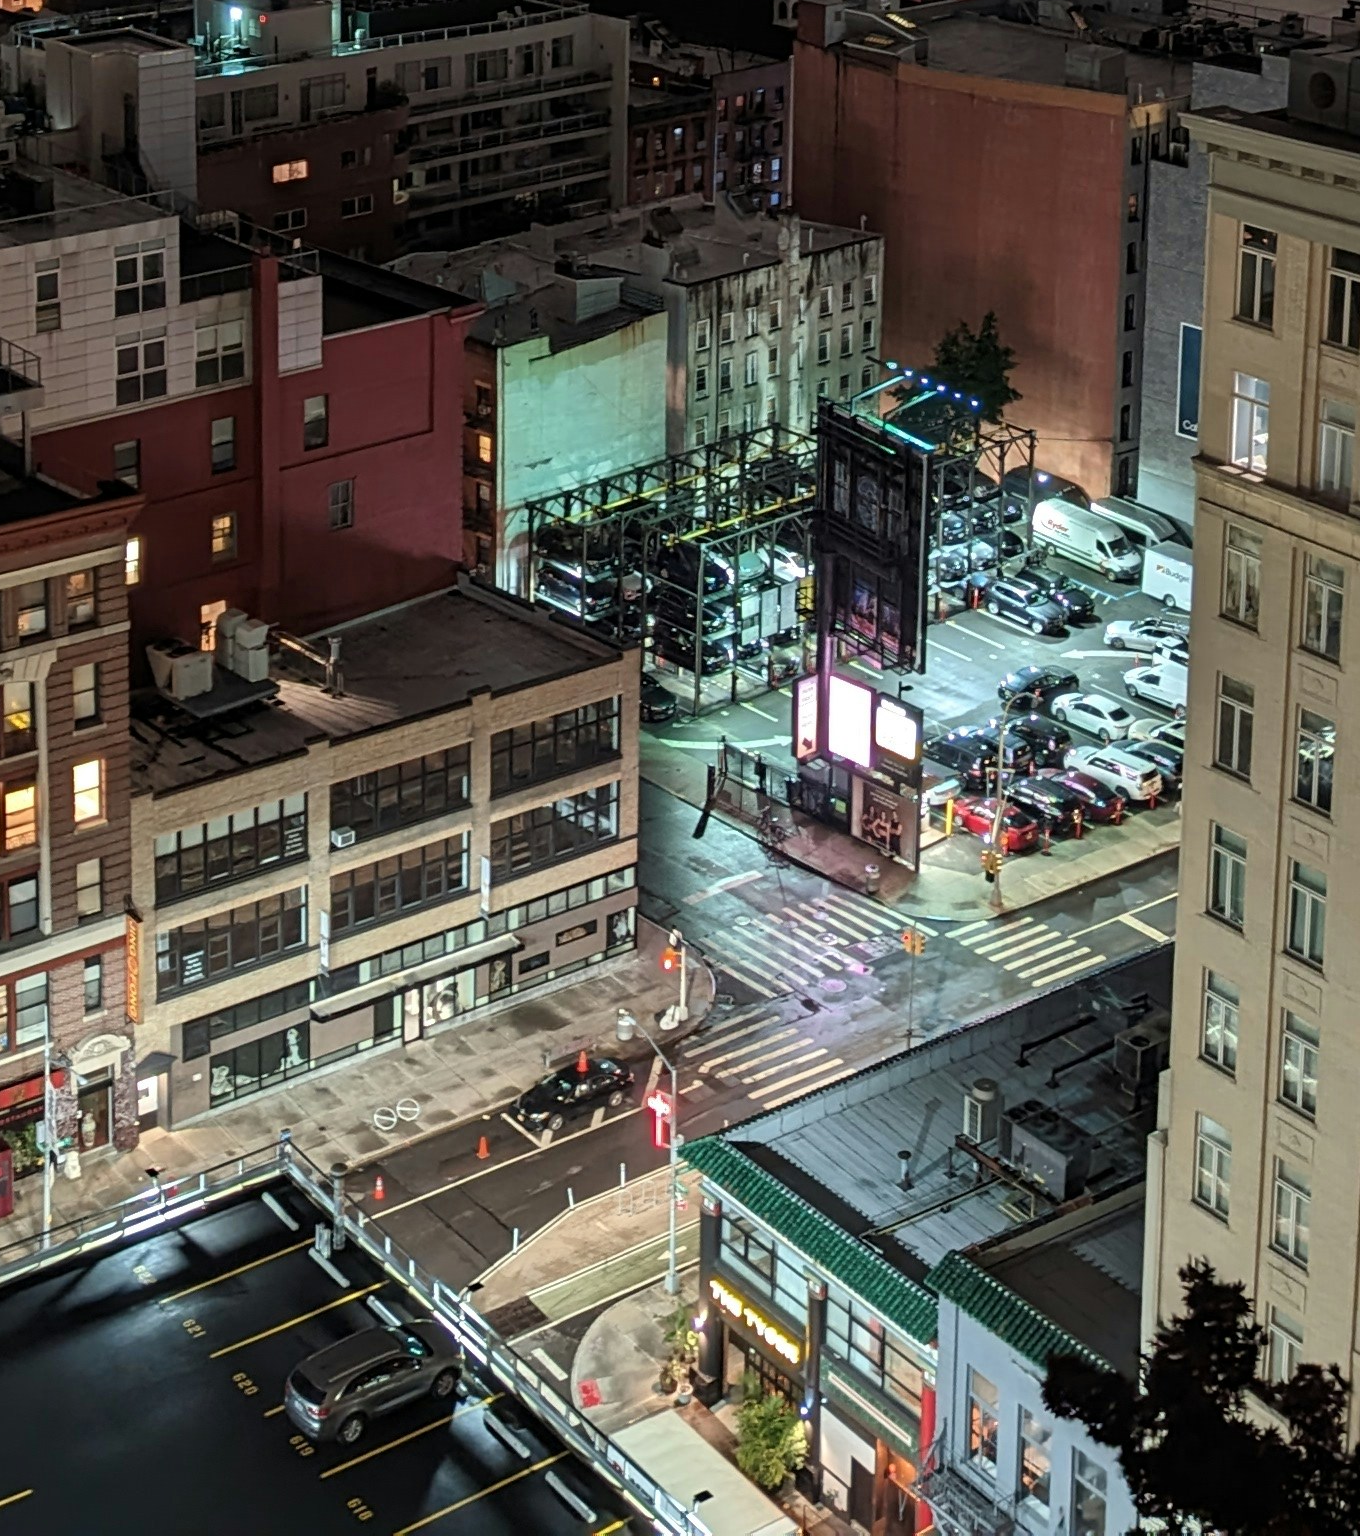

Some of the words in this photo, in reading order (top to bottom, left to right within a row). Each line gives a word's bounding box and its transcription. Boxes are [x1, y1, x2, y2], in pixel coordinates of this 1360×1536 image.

[1048, 519, 1069, 532] Ryder
[182, 1319, 206, 1338] 621
[232, 1372, 259, 1396] 620
[289, 1434, 314, 1457] 619
